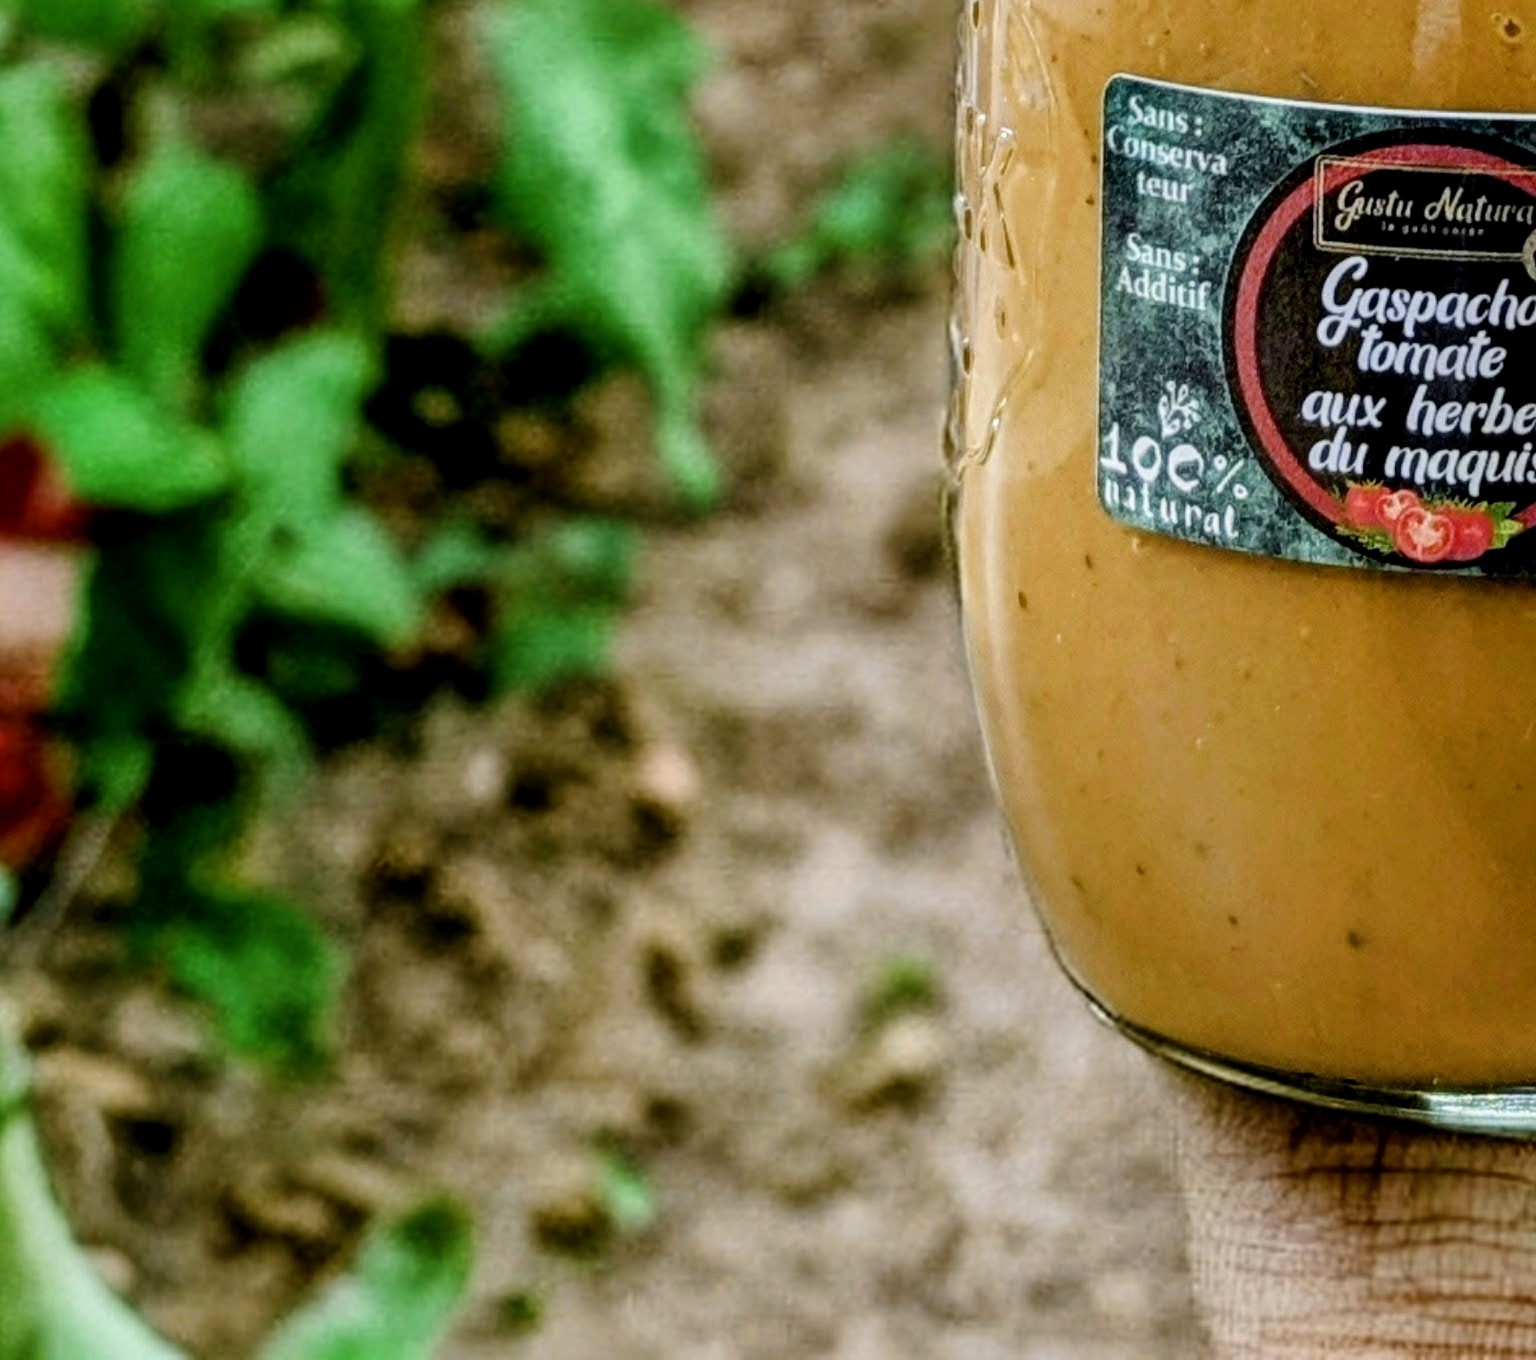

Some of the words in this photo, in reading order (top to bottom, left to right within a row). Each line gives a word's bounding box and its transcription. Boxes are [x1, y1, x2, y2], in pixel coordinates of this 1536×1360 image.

[1128, 94, 1189, 134] Sans
[1107, 124, 1228, 176] Conserva
[1137, 170, 1194, 203] teur
[1334, 180, 1414, 231] Gustu
[1424, 186, 1535, 225] Natura
[1126, 232, 1187, 273] Sans
[1115, 265, 1212, 311] Additif
[1357, 323, 1507, 381] tomate
[1300, 390, 1387, 428] aux
[1308, 425, 1369, 475] du
[1105, 478, 1239, 539] natural
